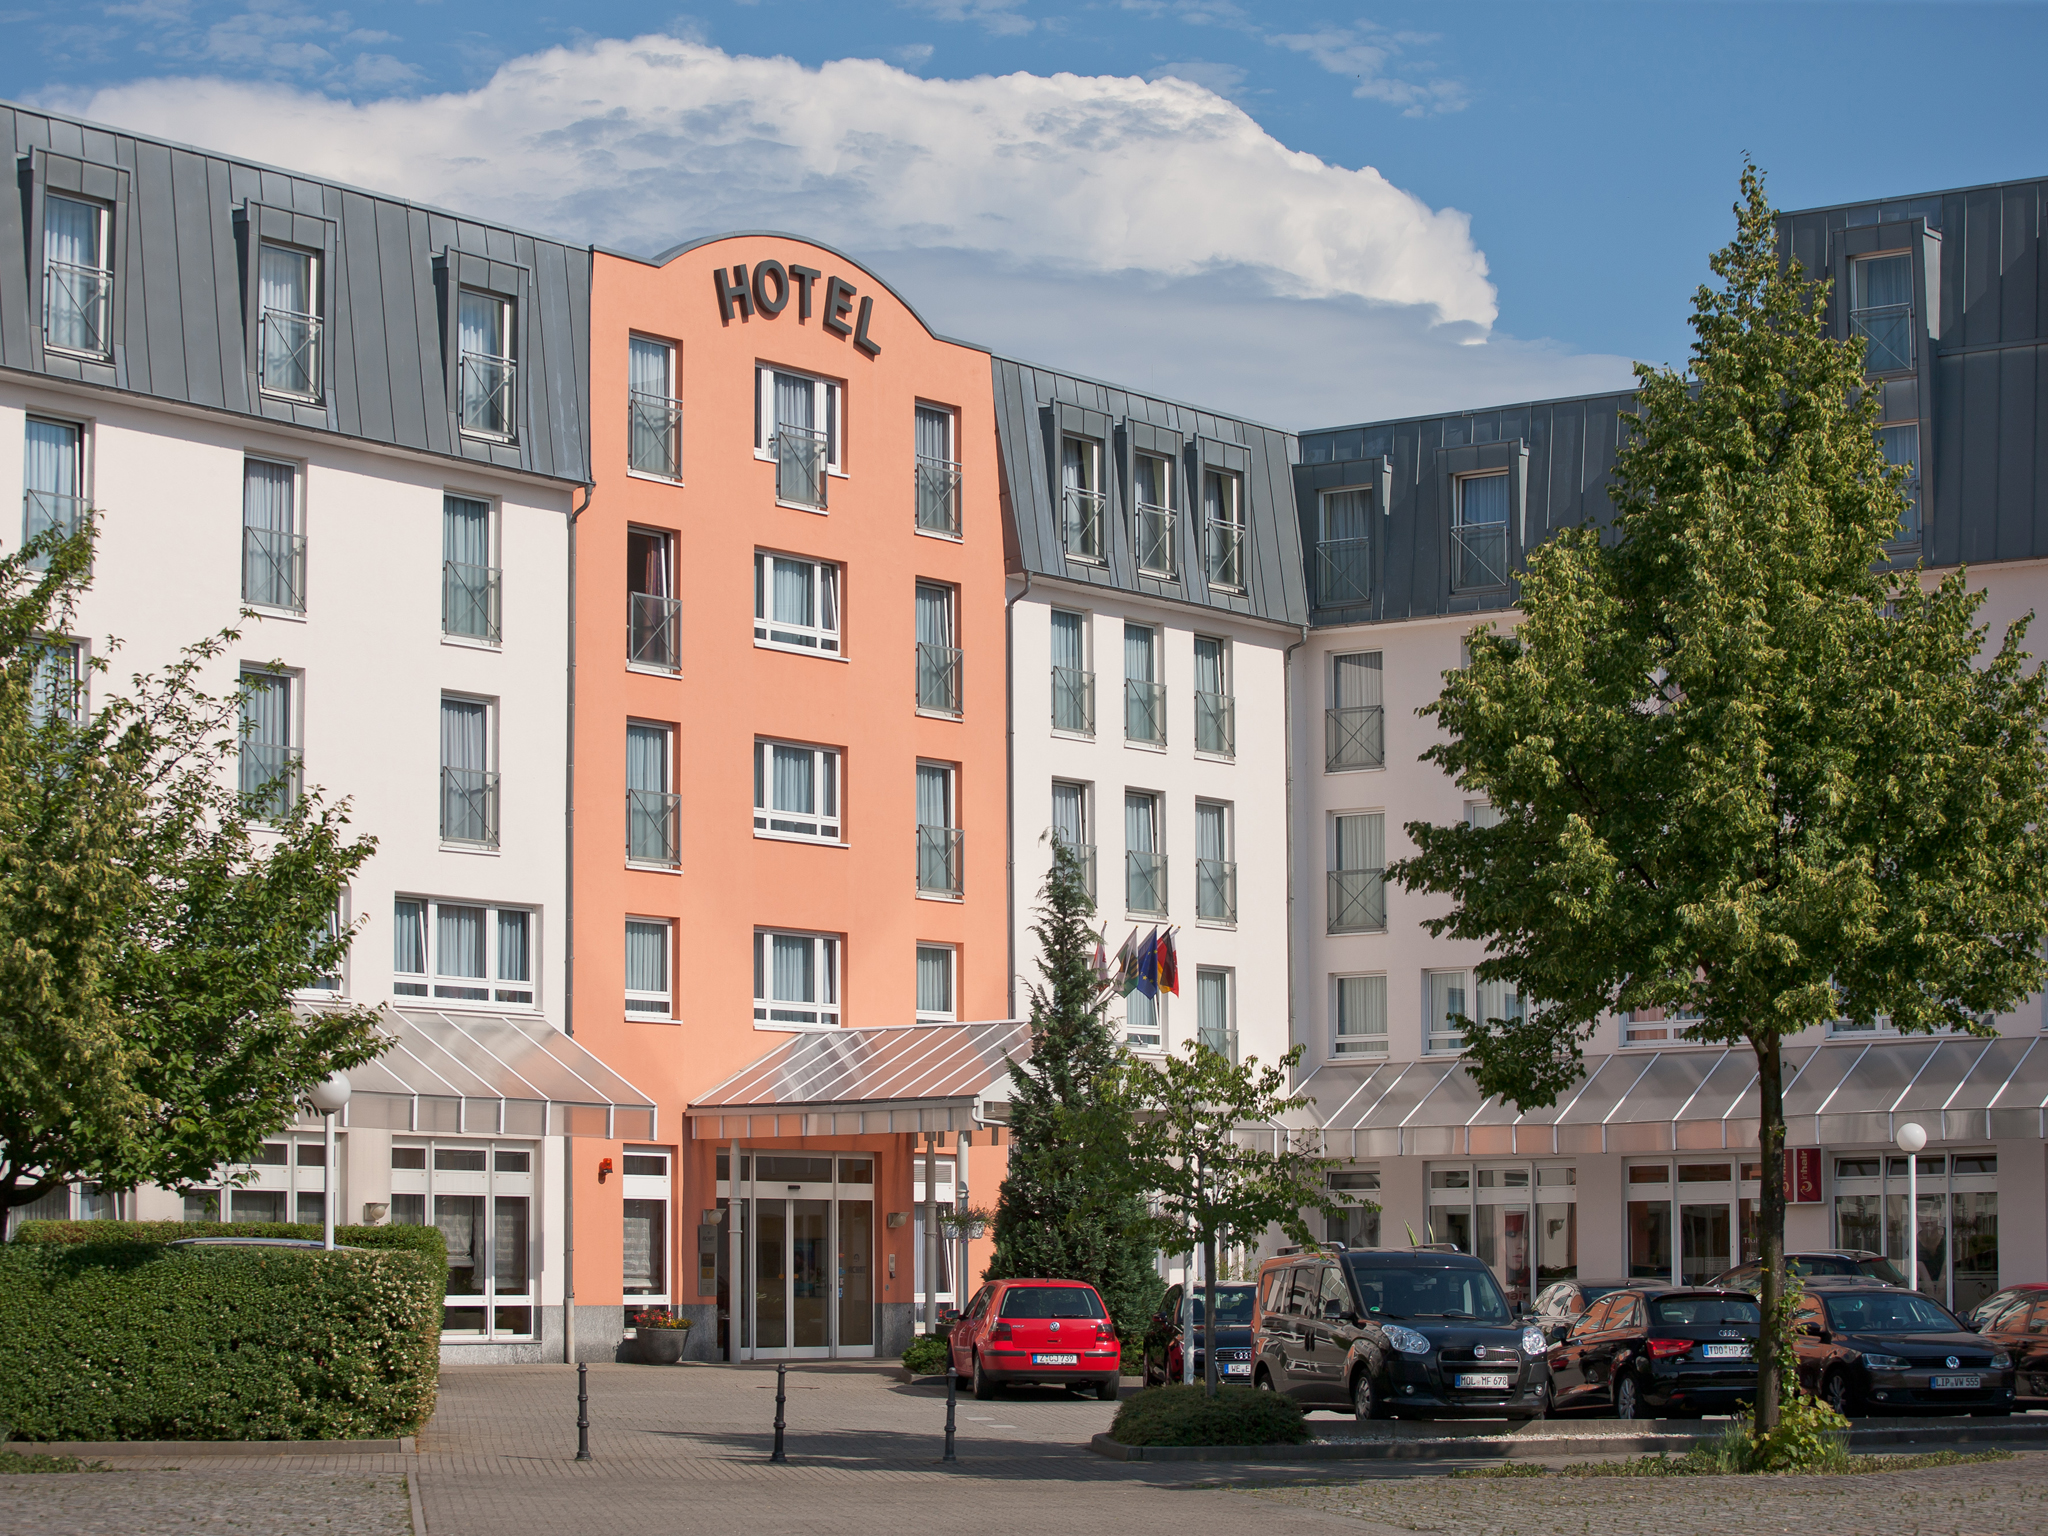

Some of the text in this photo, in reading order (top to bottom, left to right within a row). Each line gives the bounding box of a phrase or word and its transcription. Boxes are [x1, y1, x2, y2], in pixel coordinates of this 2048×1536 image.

[714, 259, 881, 355] HOTEL
[1728, 1346, 1739, 1355] HP
[1460, 1376, 1507, 1386] MOL MF 678
[1935, 1377, 1979, 1387] LIP VW 555
